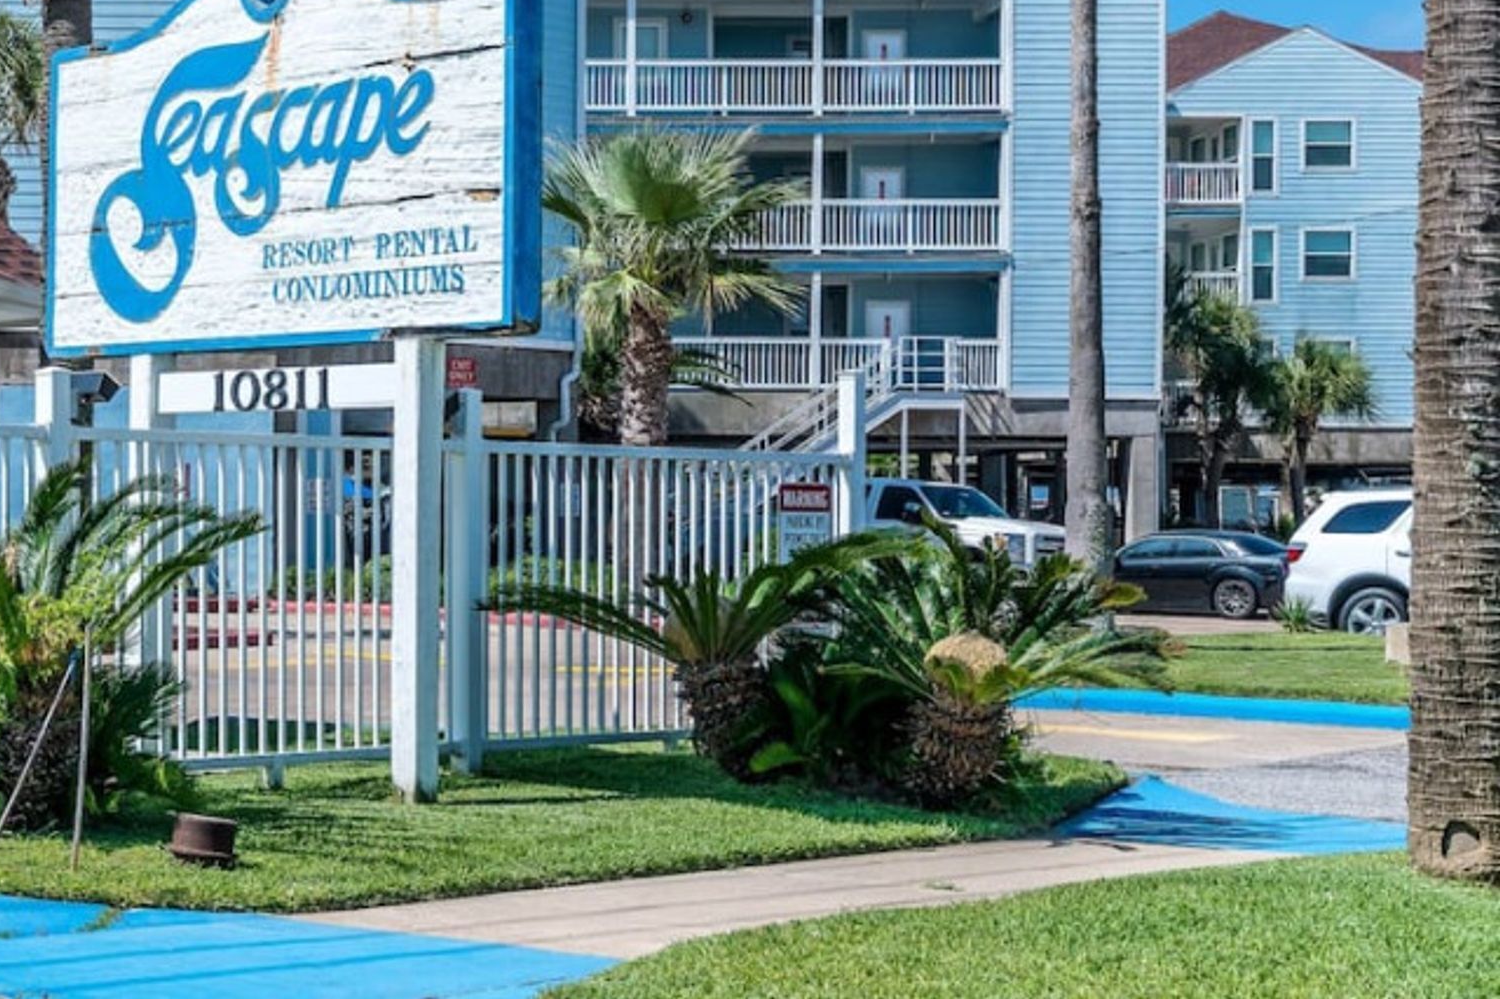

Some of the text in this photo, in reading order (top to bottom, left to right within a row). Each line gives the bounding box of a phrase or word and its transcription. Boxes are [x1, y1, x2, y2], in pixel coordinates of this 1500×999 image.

[90, 30, 434, 323] Seascape
[262, 236, 353, 269] RESORT
[272, 264, 465, 303] CONDOMINIUMS
[213, 368, 329, 412] 10811
[783, 490, 828, 507] WARNING
